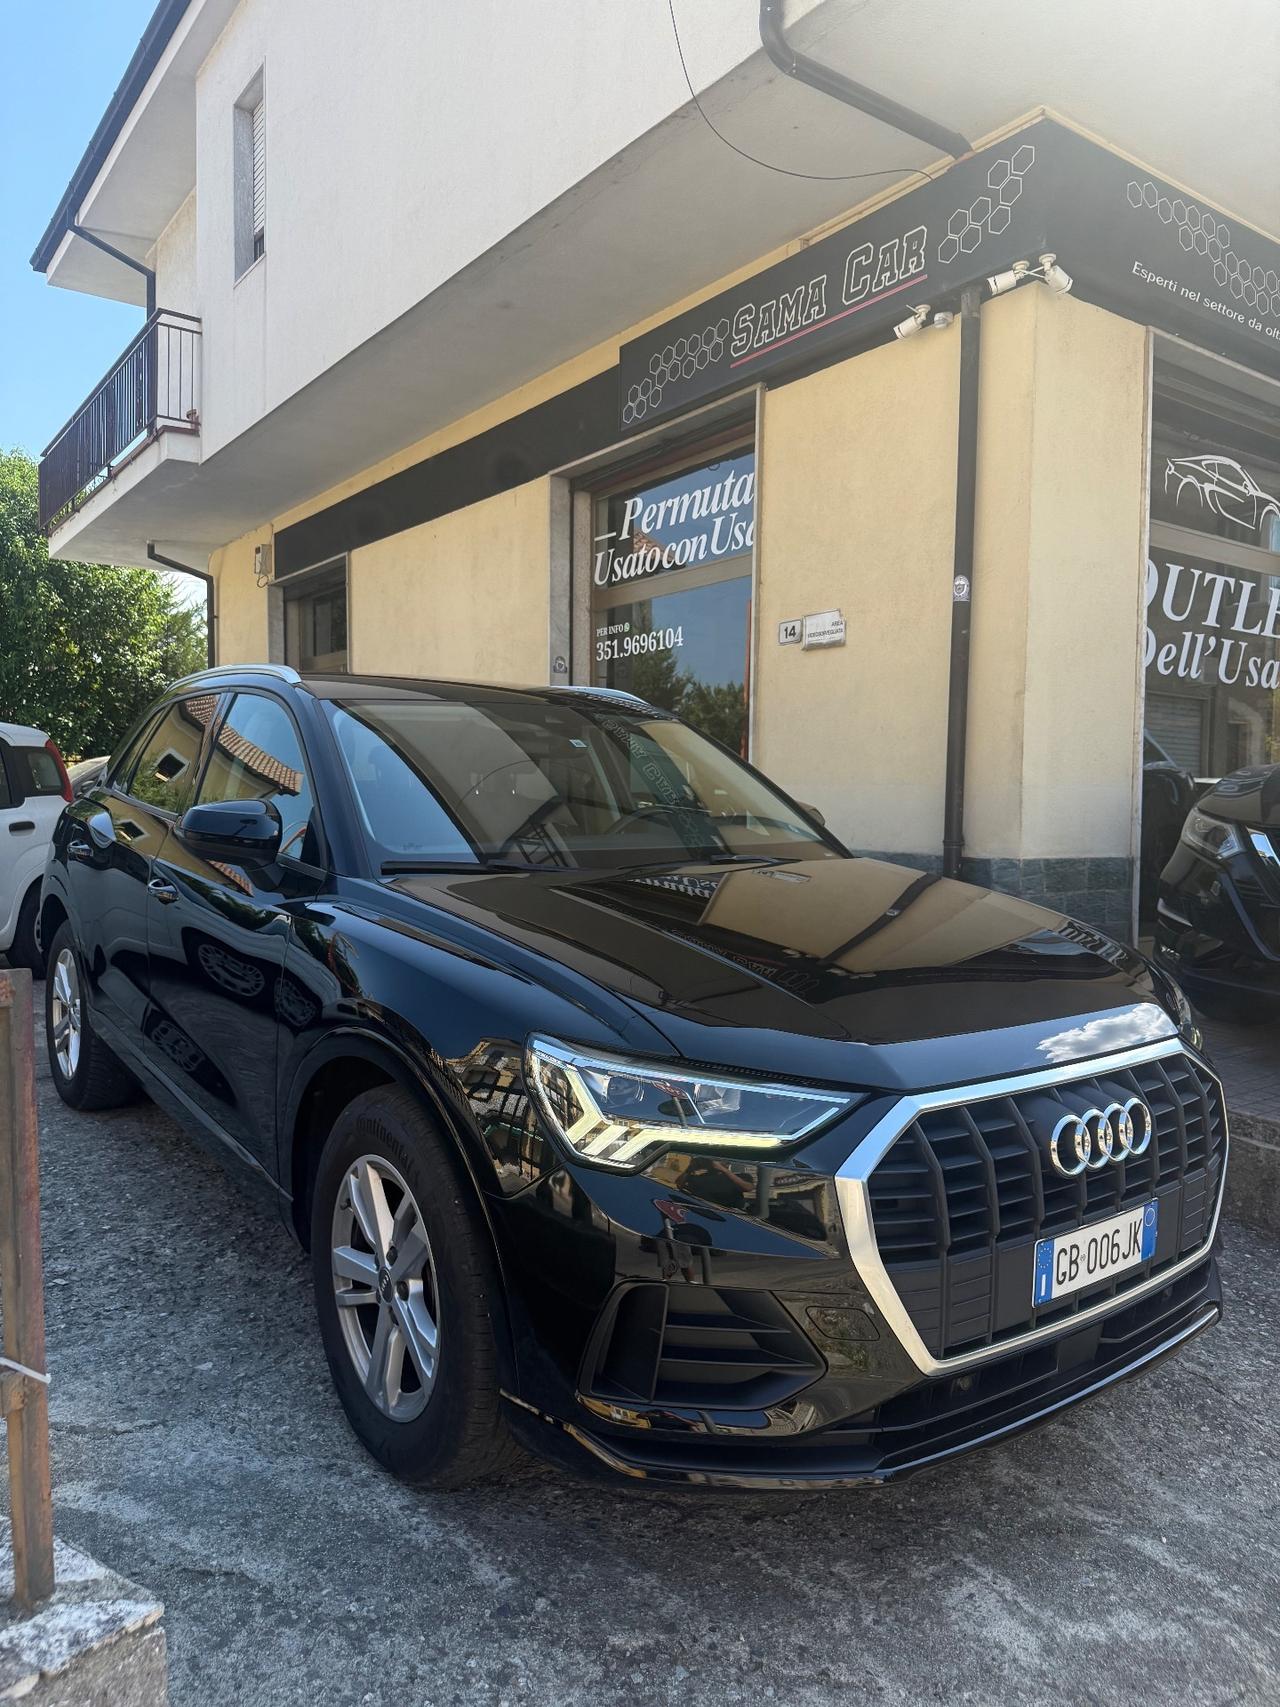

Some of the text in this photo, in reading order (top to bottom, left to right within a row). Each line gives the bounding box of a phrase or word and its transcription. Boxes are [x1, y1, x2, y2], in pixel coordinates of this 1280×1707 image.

[730, 274, 827, 358] SAMA
[1132, 260, 1280, 340] Esperti nel settore da olt
[619, 470, 755, 540] Permuta
[593, 548, 660, 586] Usato
[662, 532, 708, 569] con
[596, 624, 624, 637] PER INFO
[596, 626, 684, 662] 351.9696104
[784, 625, 796, 639] 14
